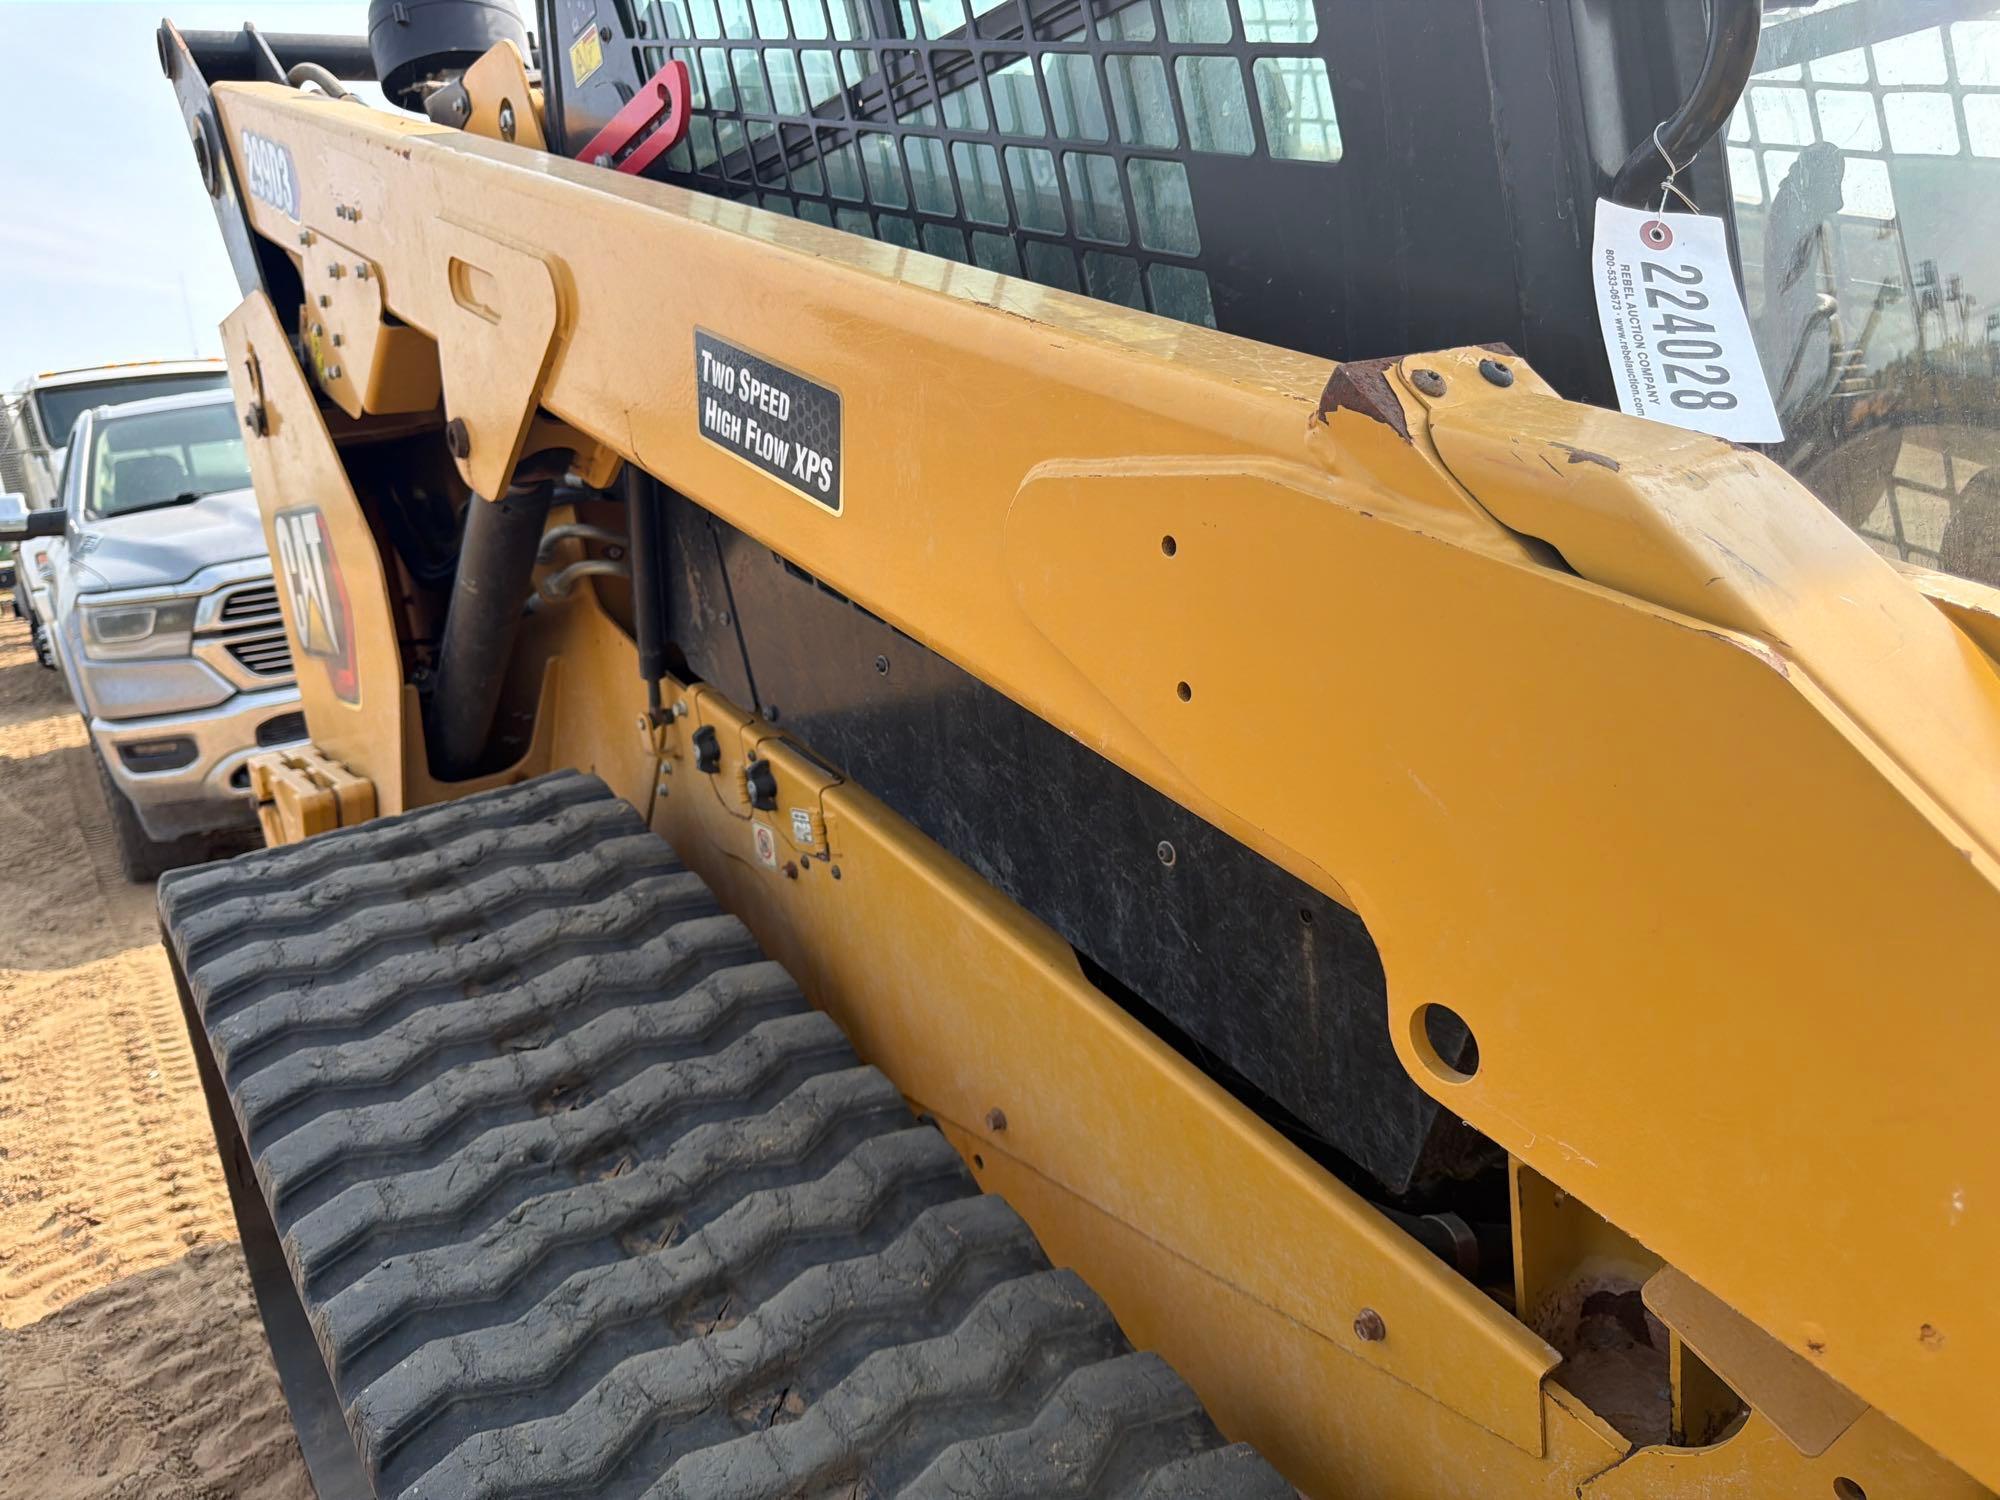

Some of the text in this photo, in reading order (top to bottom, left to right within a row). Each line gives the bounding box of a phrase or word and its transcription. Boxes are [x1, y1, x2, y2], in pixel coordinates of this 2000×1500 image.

[1605, 249, 1645, 416] 800-533-0673 www.rebelauction.com
[1620, 264, 1661, 406] REBEL AUCTION COMPANY
[1640, 261, 1738, 411] 224028
[792, 442, 833, 493] XPS
[275, 512, 339, 654] CAT
